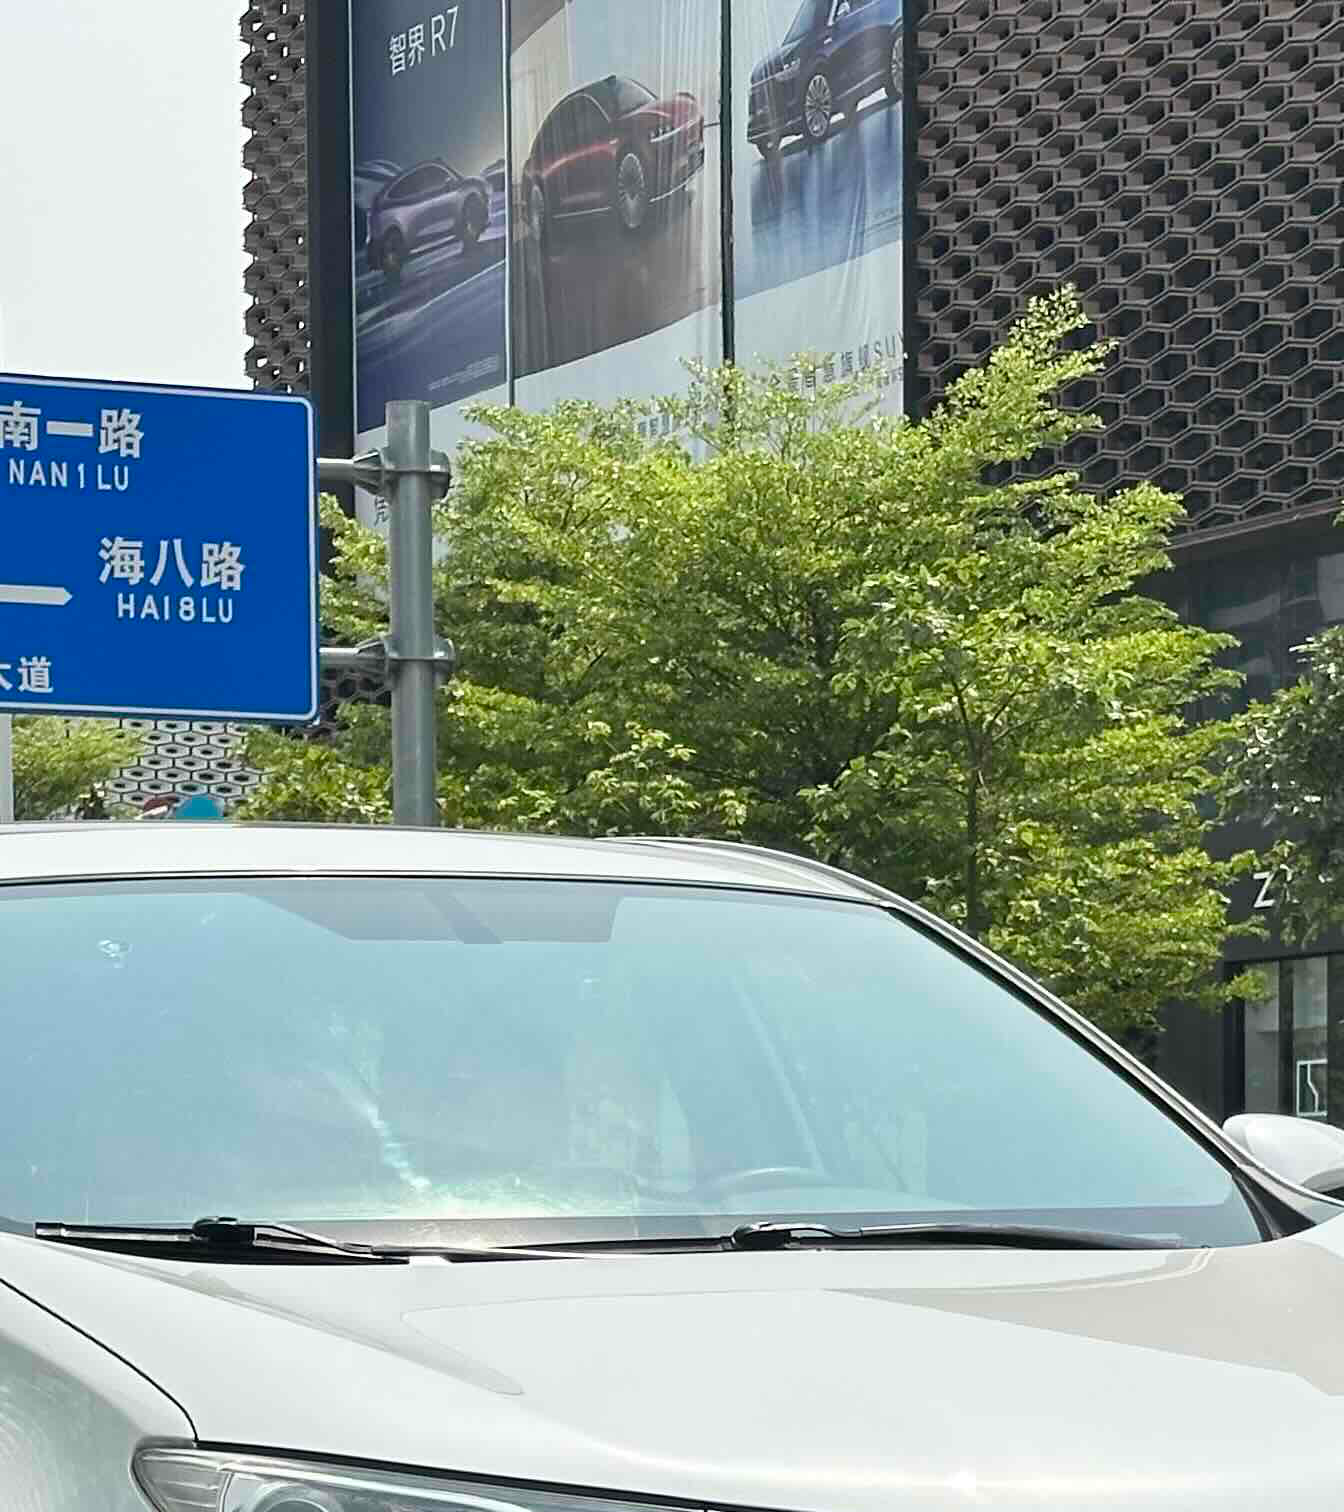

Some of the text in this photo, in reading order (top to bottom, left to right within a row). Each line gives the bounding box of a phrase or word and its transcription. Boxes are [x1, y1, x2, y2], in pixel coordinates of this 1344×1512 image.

[390, 5, 459, 76] 智界 R7
[98, 536, 246, 591] 海八路
